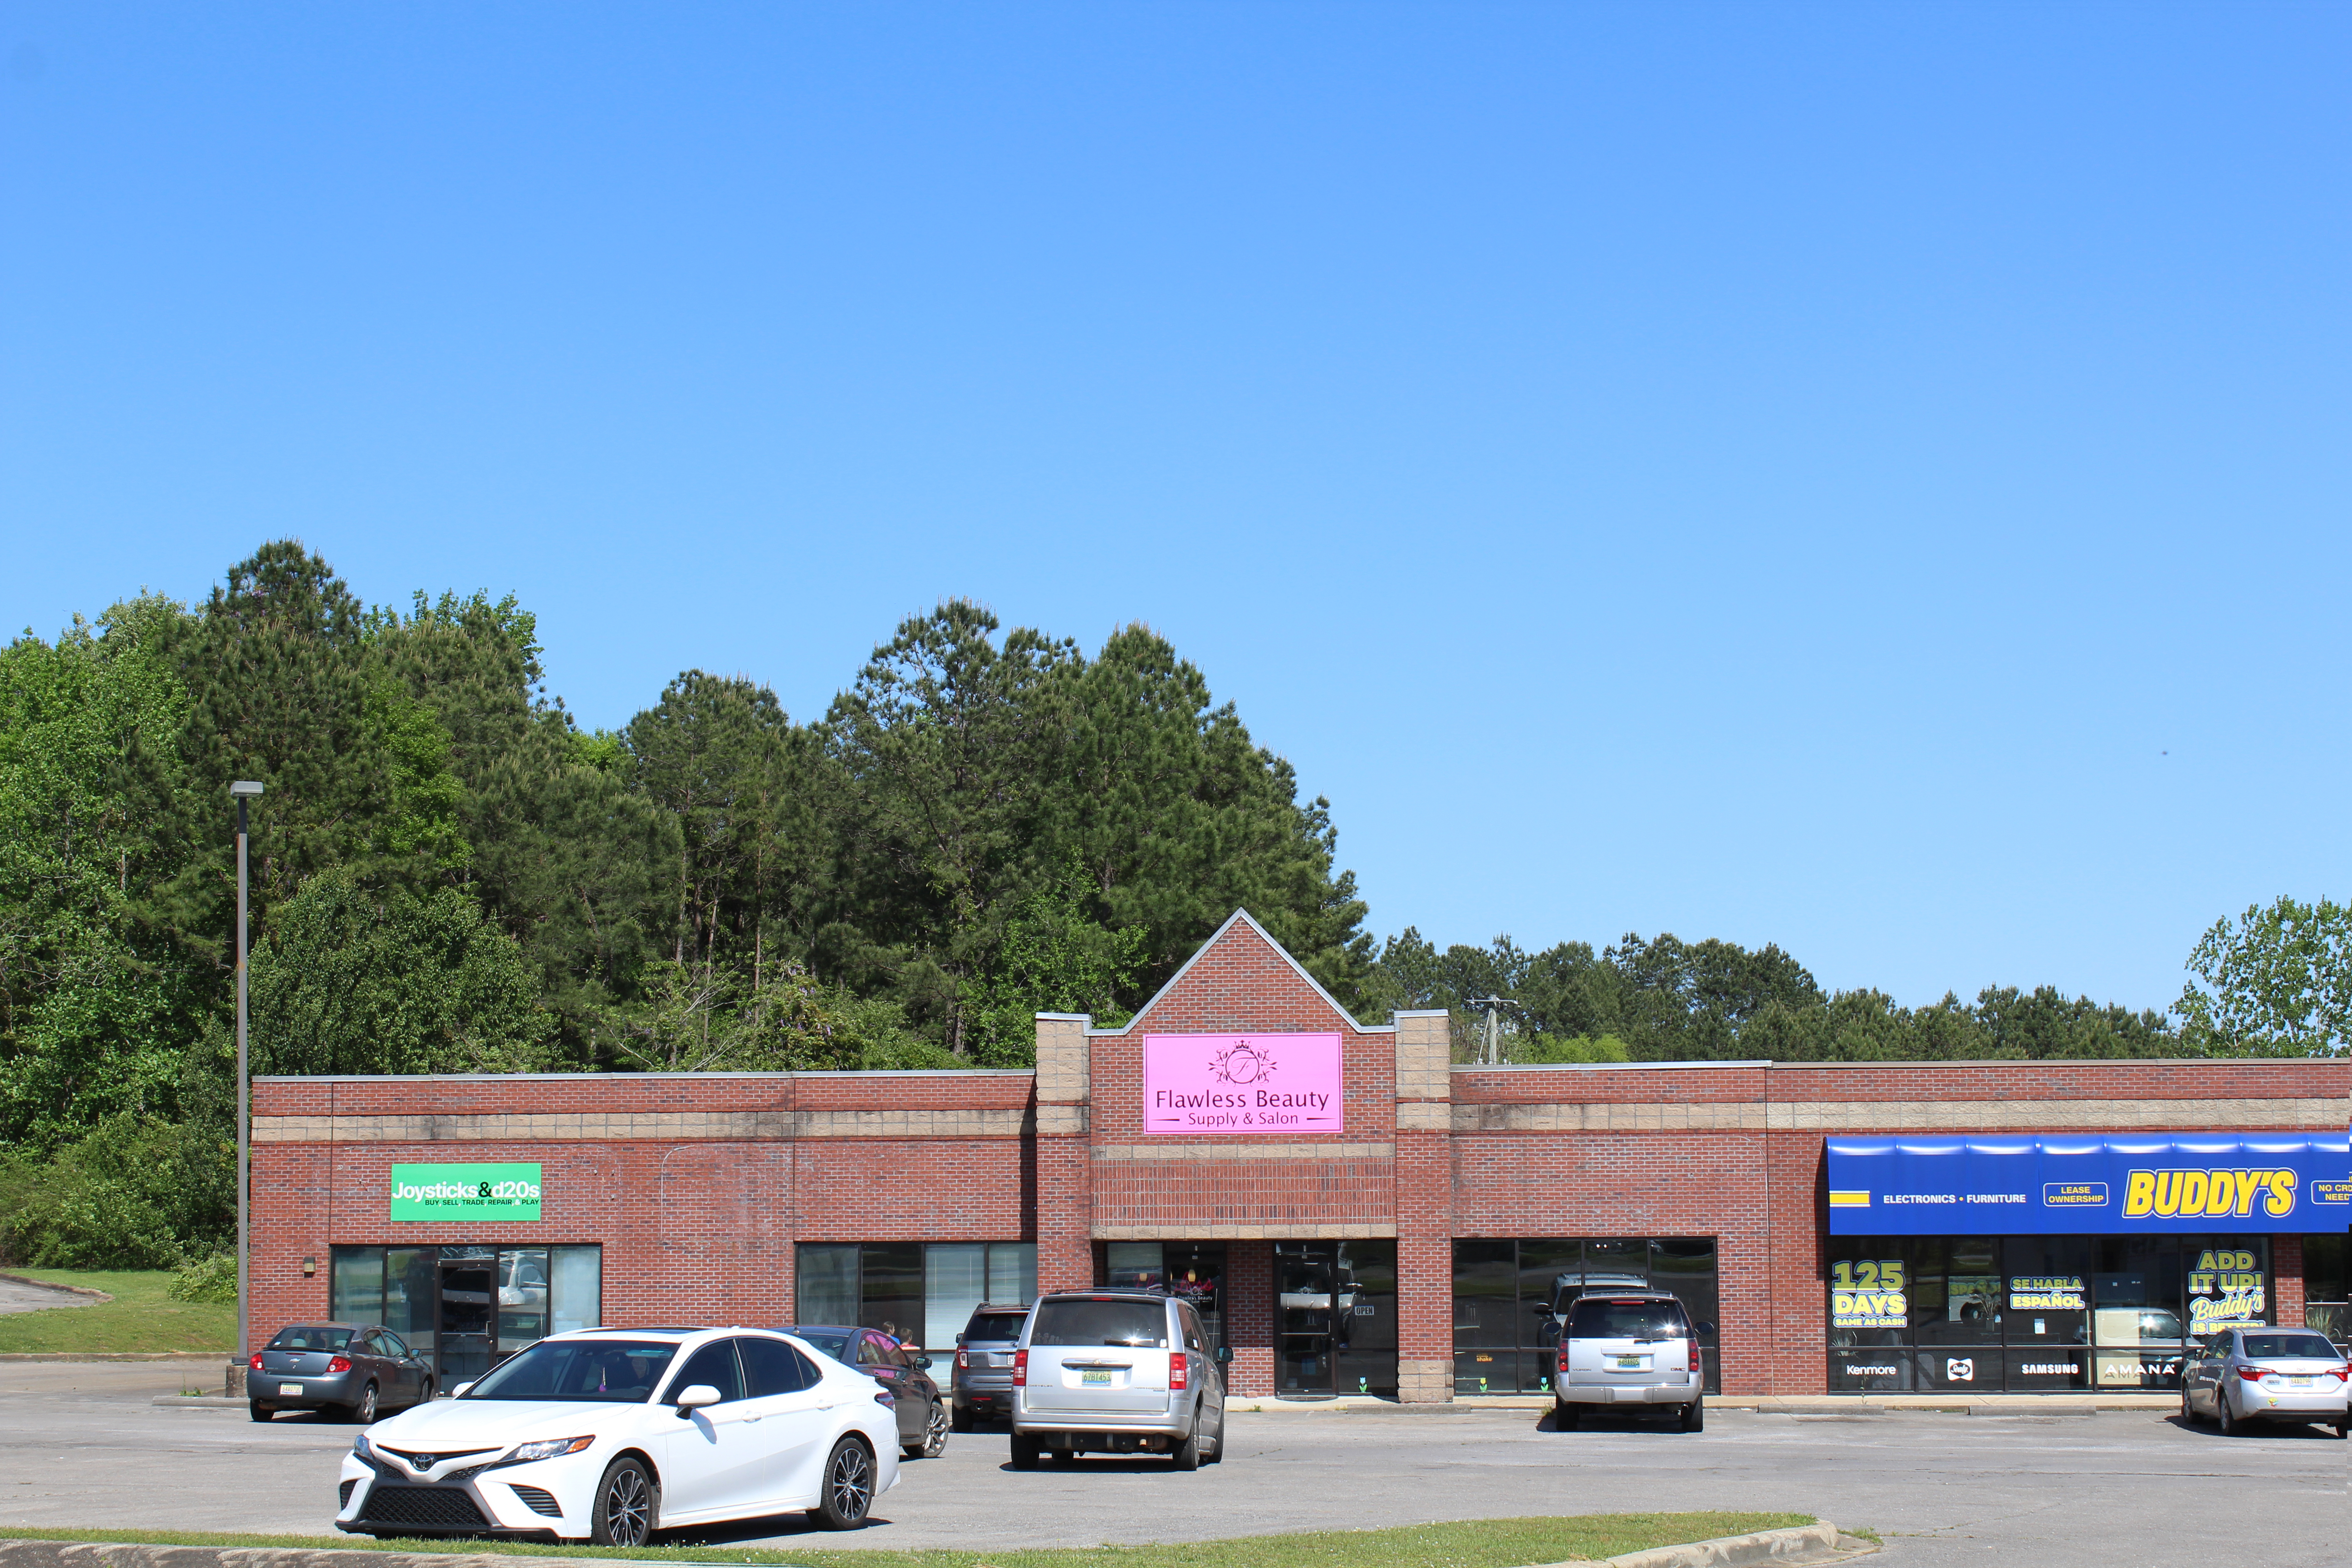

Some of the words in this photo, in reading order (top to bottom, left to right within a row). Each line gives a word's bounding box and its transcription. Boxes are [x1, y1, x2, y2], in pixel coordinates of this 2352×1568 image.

[1156, 1089, 1246, 1108] Flawless
[1257, 1090, 1329, 1111] Beauty
[1188, 1112, 1238, 1127] Supply
[1243, 1112, 1253, 1125] &
[1259, 1112, 1298, 1124] Salon
[2123, 1169, 2296, 1217] BUDDY'S
[1883, 1194, 1955, 1204] ELECTRONICS
[1966, 1194, 2026, 1204] FURNITURE
[2048, 1195, 2104, 1203] OWNERSHIP
[2198, 1252, 2254, 1270] ADD
[1833, 1261, 1904, 1291] 125
[2012, 1279, 2030, 1289] SE
[2033, 1279, 2082, 1289] HABLA
[2190, 1274, 2215, 1292] IT
[2220, 1274, 2263, 1292] UP!
[1834, 1294, 1906, 1315] DAYS
[2012, 1292, 2083, 1308] ESPAÑOL
[1356, 1307, 1373, 1315] OPEN
[2191, 1293, 2264, 1321] Buddy's
[1835, 1318, 1862, 1326] SAME
[1863, 1318, 1877, 1326] AS
[1878, 1318, 1905, 1326] CASH
[2192, 1322, 2206, 1333] IS
[1846, 1365, 1896, 1375] Kenmore
[2022, 1364, 2079, 1374] SAMSUNG
[2105, 1364, 2175, 1374] AMANA
[1083, 1373, 1110, 1381] 67BT453
